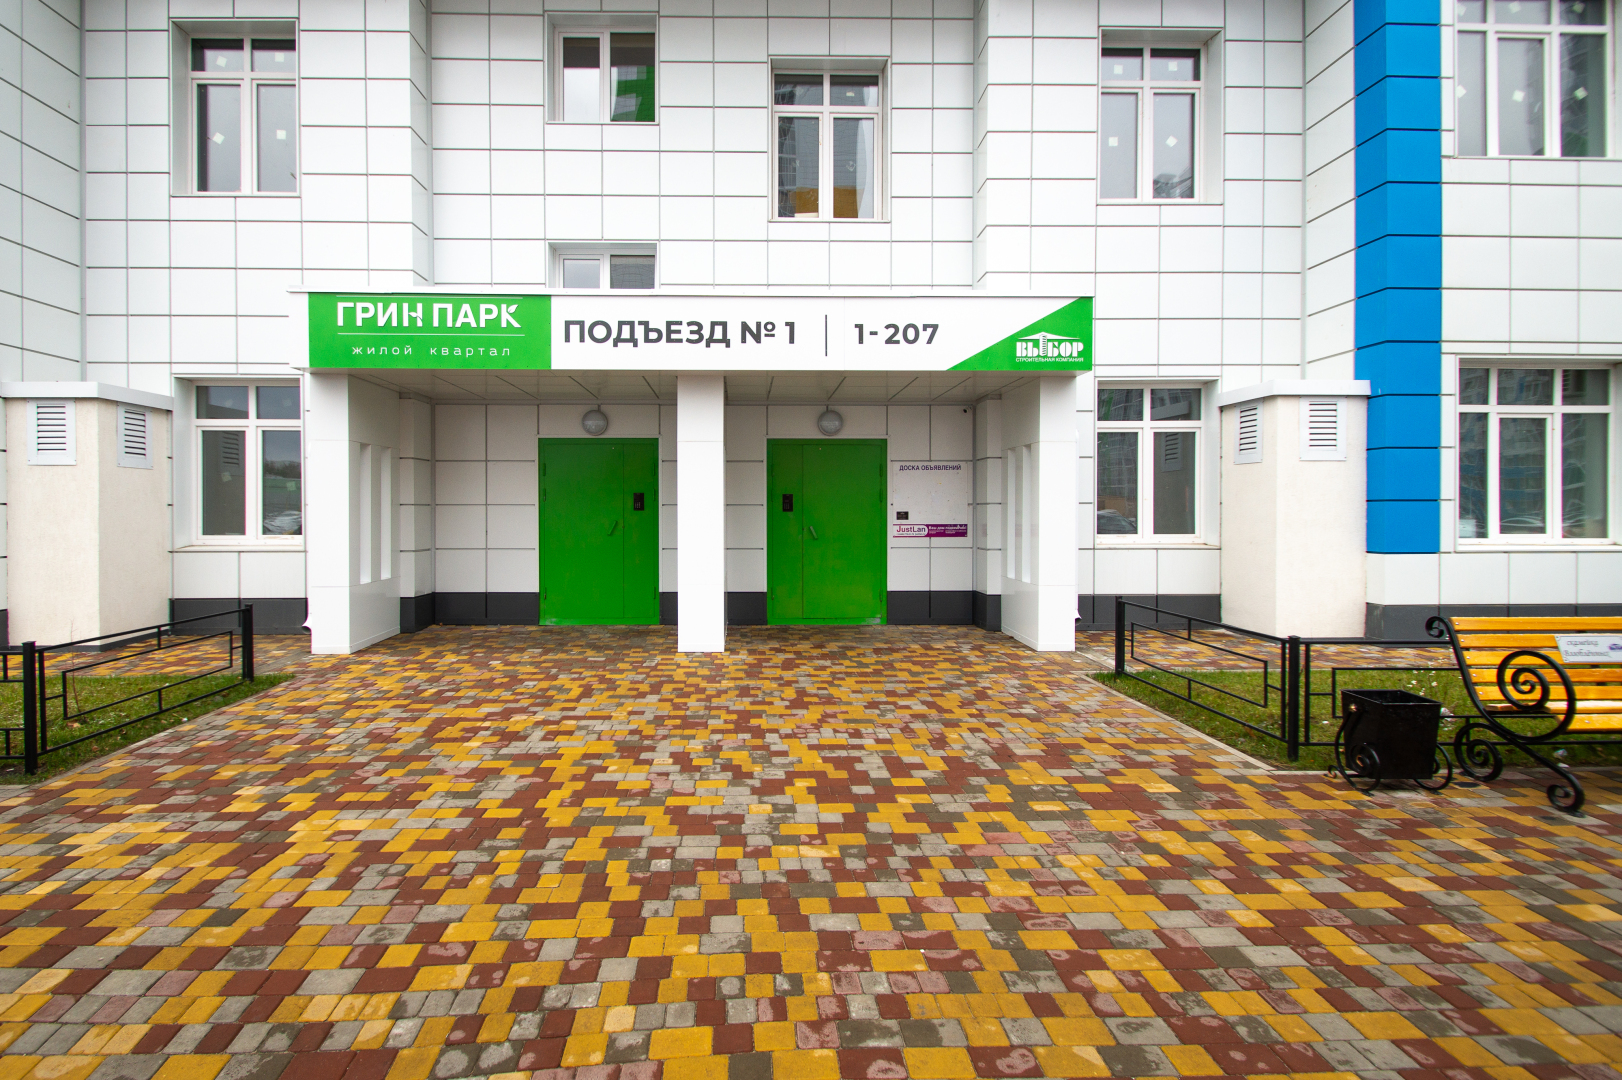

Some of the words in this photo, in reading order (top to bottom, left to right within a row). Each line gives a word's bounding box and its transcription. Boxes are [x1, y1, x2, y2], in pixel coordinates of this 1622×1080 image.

[336, 302, 423, 328] ГРИН
[432, 303, 522, 329] ПАРК
[564, 319, 731, 348] ПОДЪЕЗД
[740, 320, 776, 345] №
[784, 321, 796, 345] 1
[352, 345, 412, 355] жилой
[430, 346, 511, 358] квартал
[1016, 339, 1084, 358] ВЫБОР
[896, 525, 926, 533] JustLan
